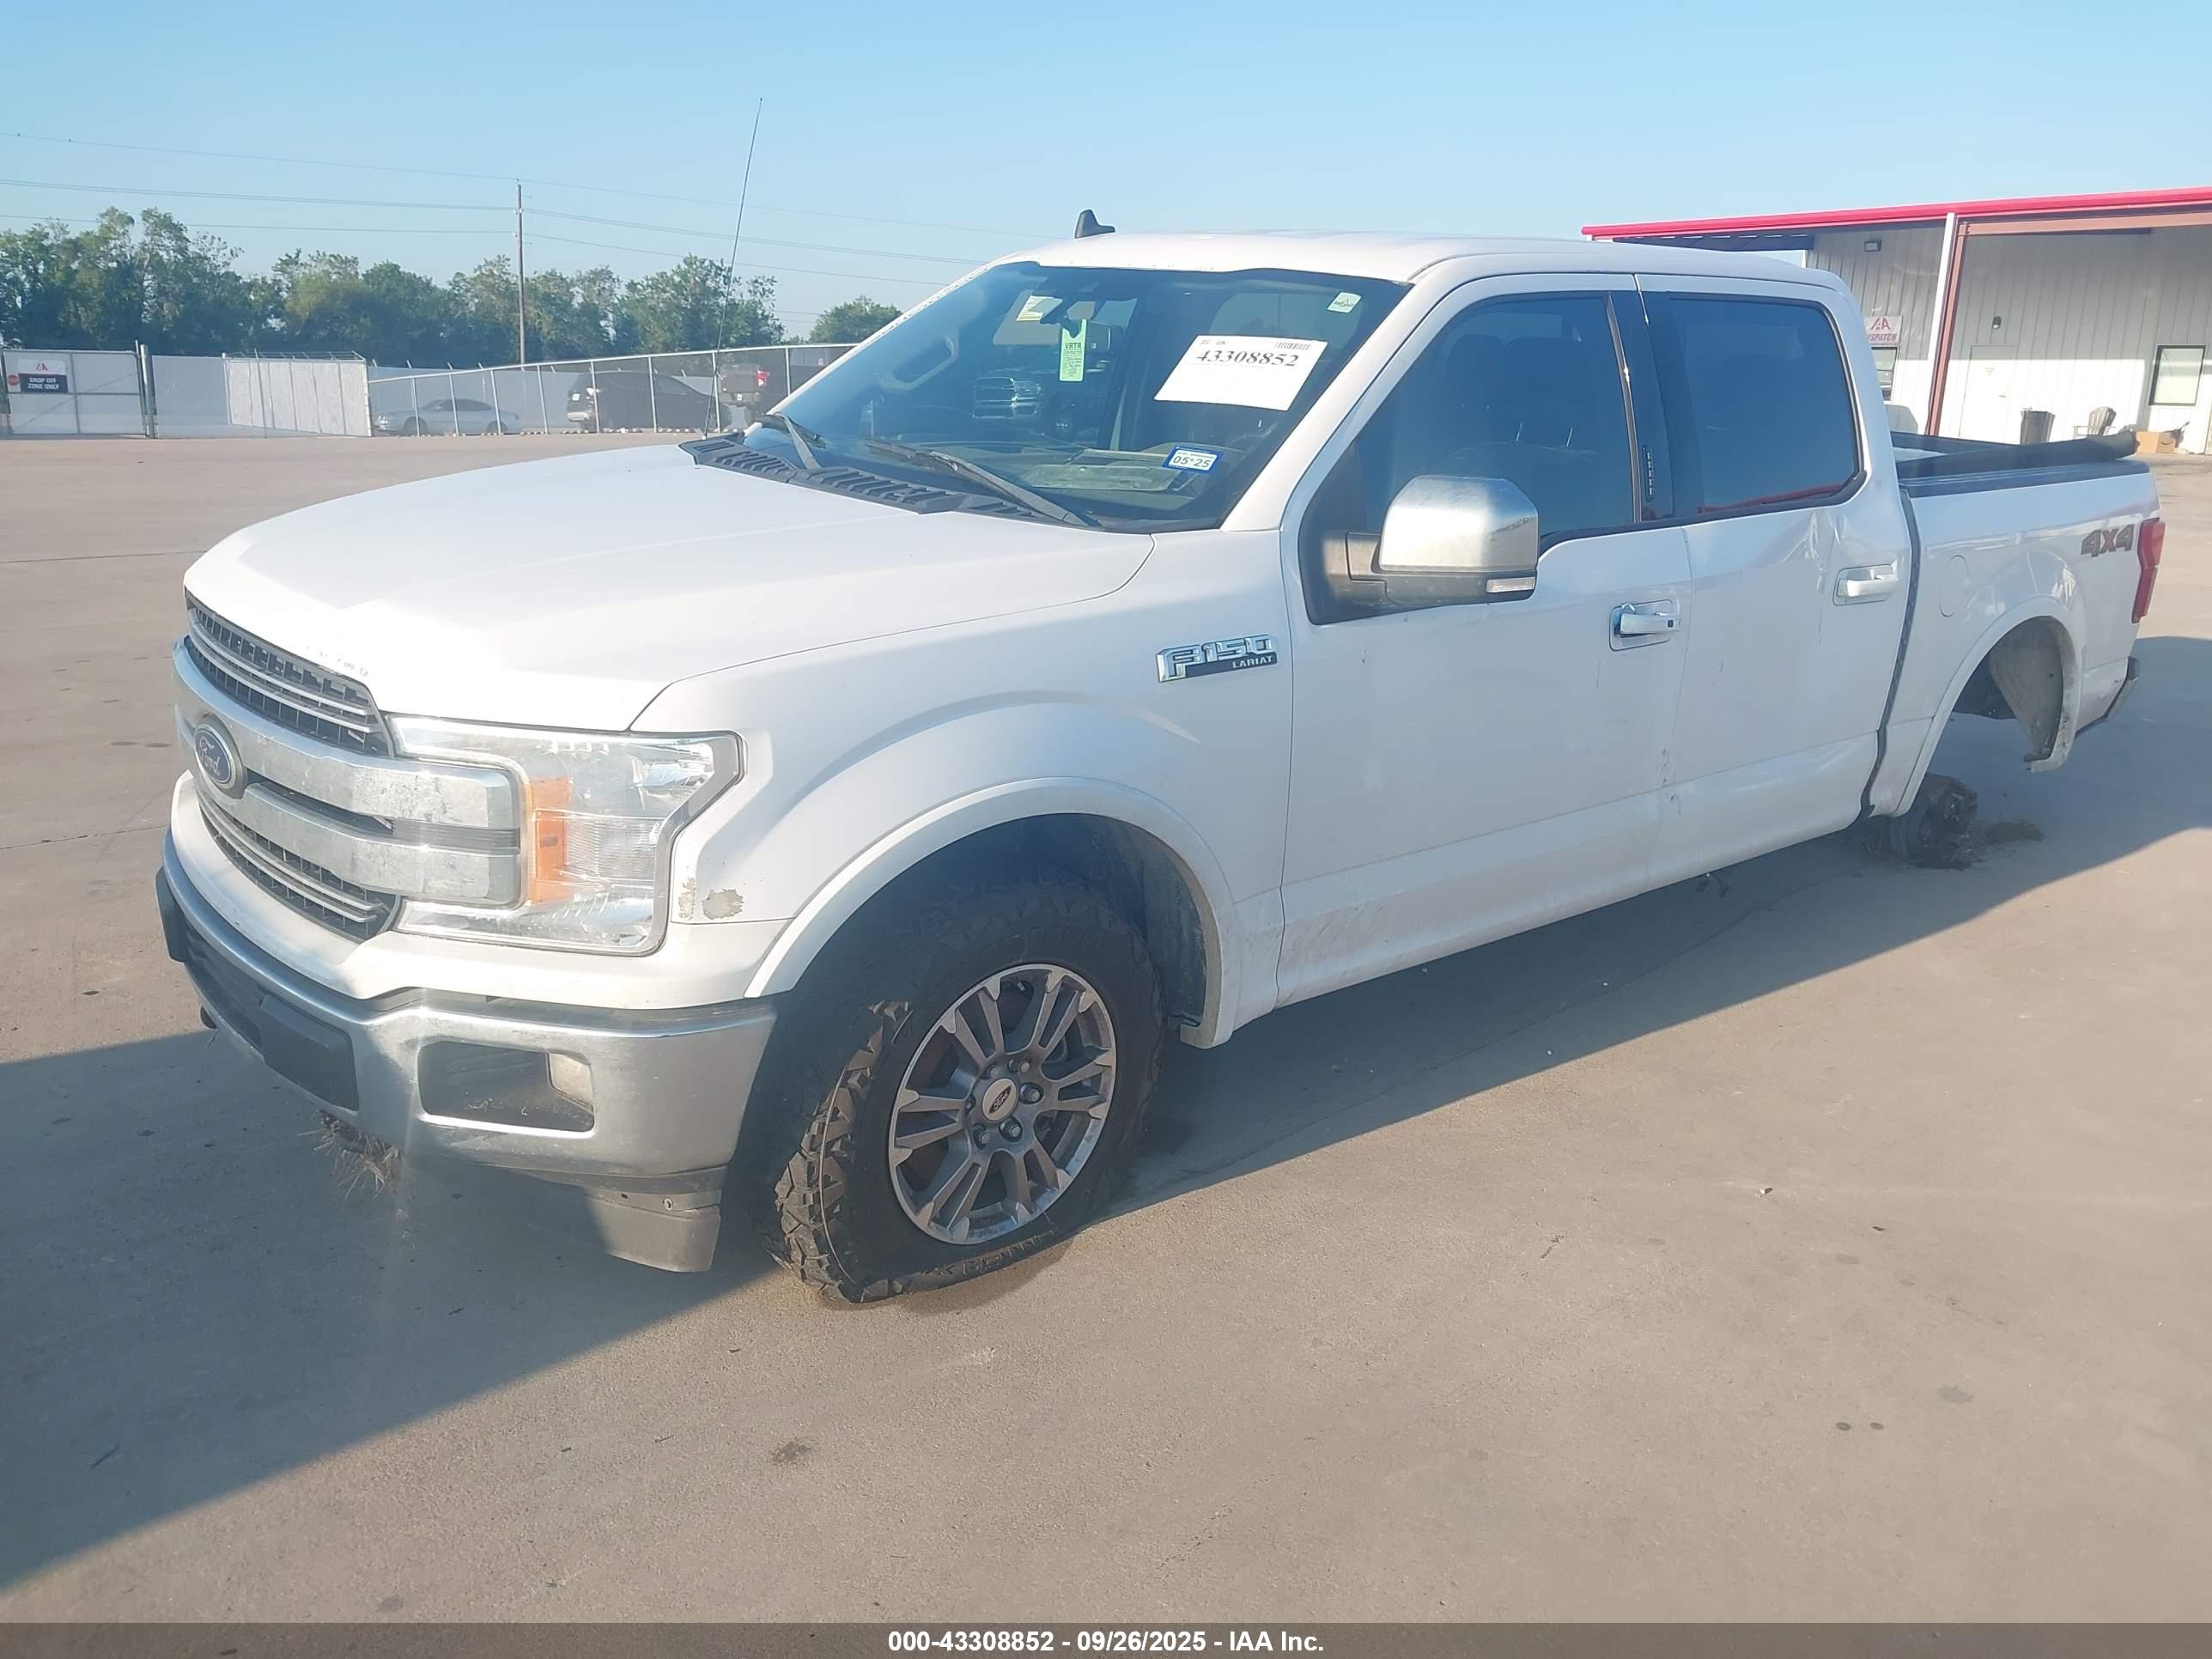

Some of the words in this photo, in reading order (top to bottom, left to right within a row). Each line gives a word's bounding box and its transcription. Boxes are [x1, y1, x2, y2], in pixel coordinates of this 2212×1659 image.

[1196, 349, 1299, 367] 43308852
[1173, 455, 1189, 465] 05
[1194, 459, 1212, 468] 25
[1232, 655, 1273, 669] LARIAT
[198, 736, 221, 776] Ford
[994, 1090, 1010, 1111] Ford
